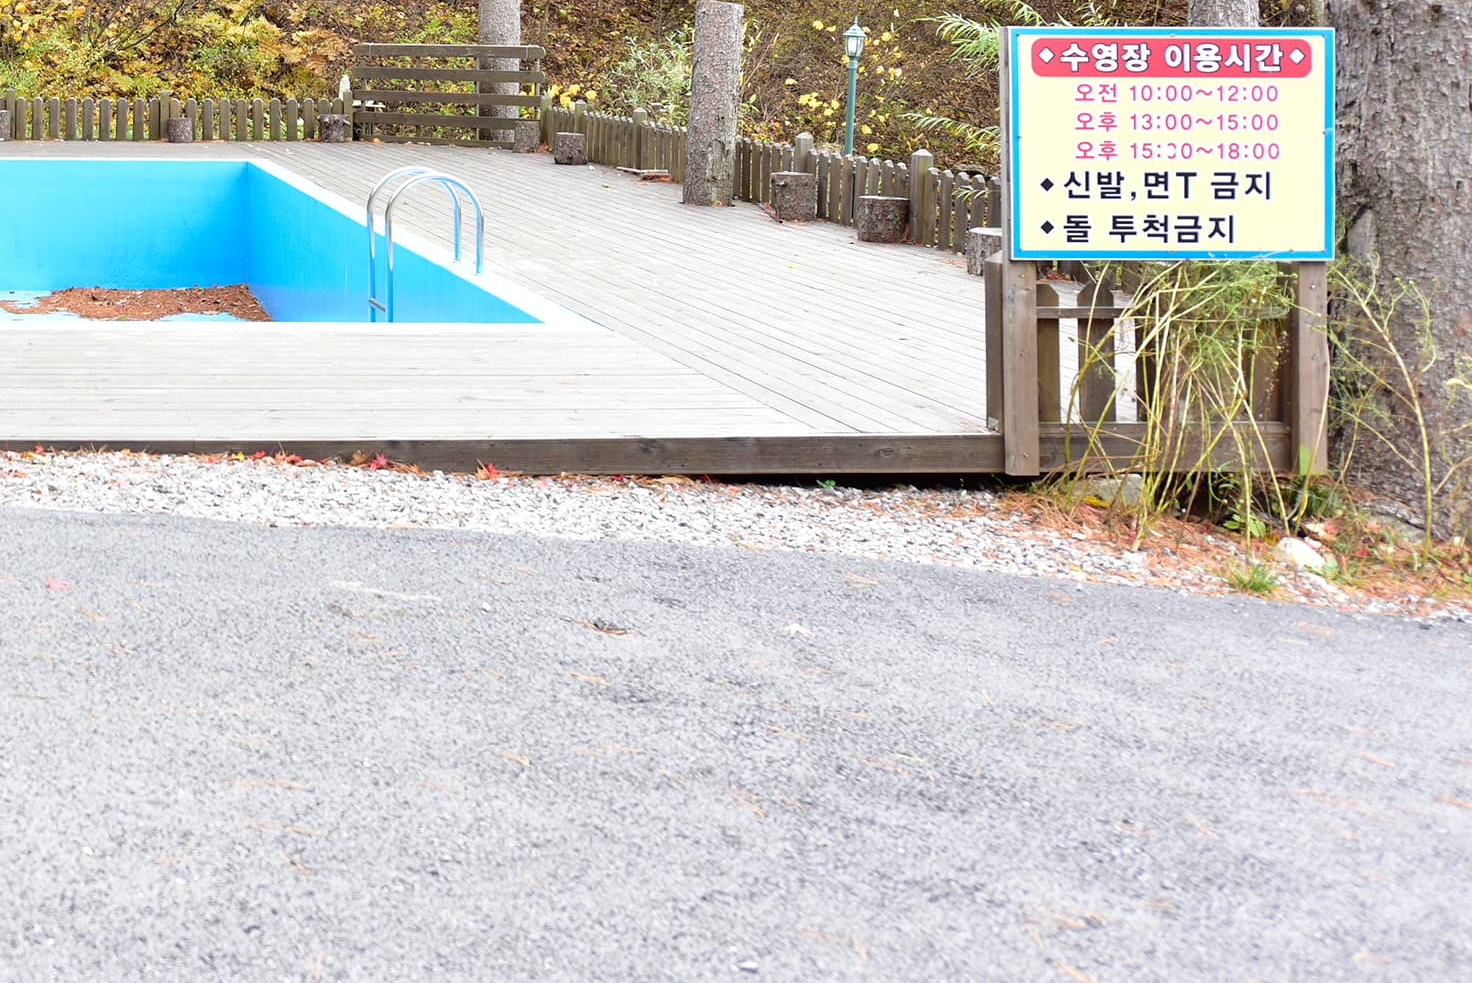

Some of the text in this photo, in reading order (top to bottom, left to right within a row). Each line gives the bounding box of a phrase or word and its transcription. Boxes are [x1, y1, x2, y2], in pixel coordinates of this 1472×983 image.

[1058, 42, 1284, 73] 수영장 이용시간
[1074, 83, 1278, 103] 오전 10:00~12:00
[1074, 111, 1279, 132] 오후 13:00~15:00
[1074, 140, 1118, 160] 오후
[1063, 170, 1271, 201] 신발,면T 금지
[1063, 214, 1234, 244] 돌 투척금지
